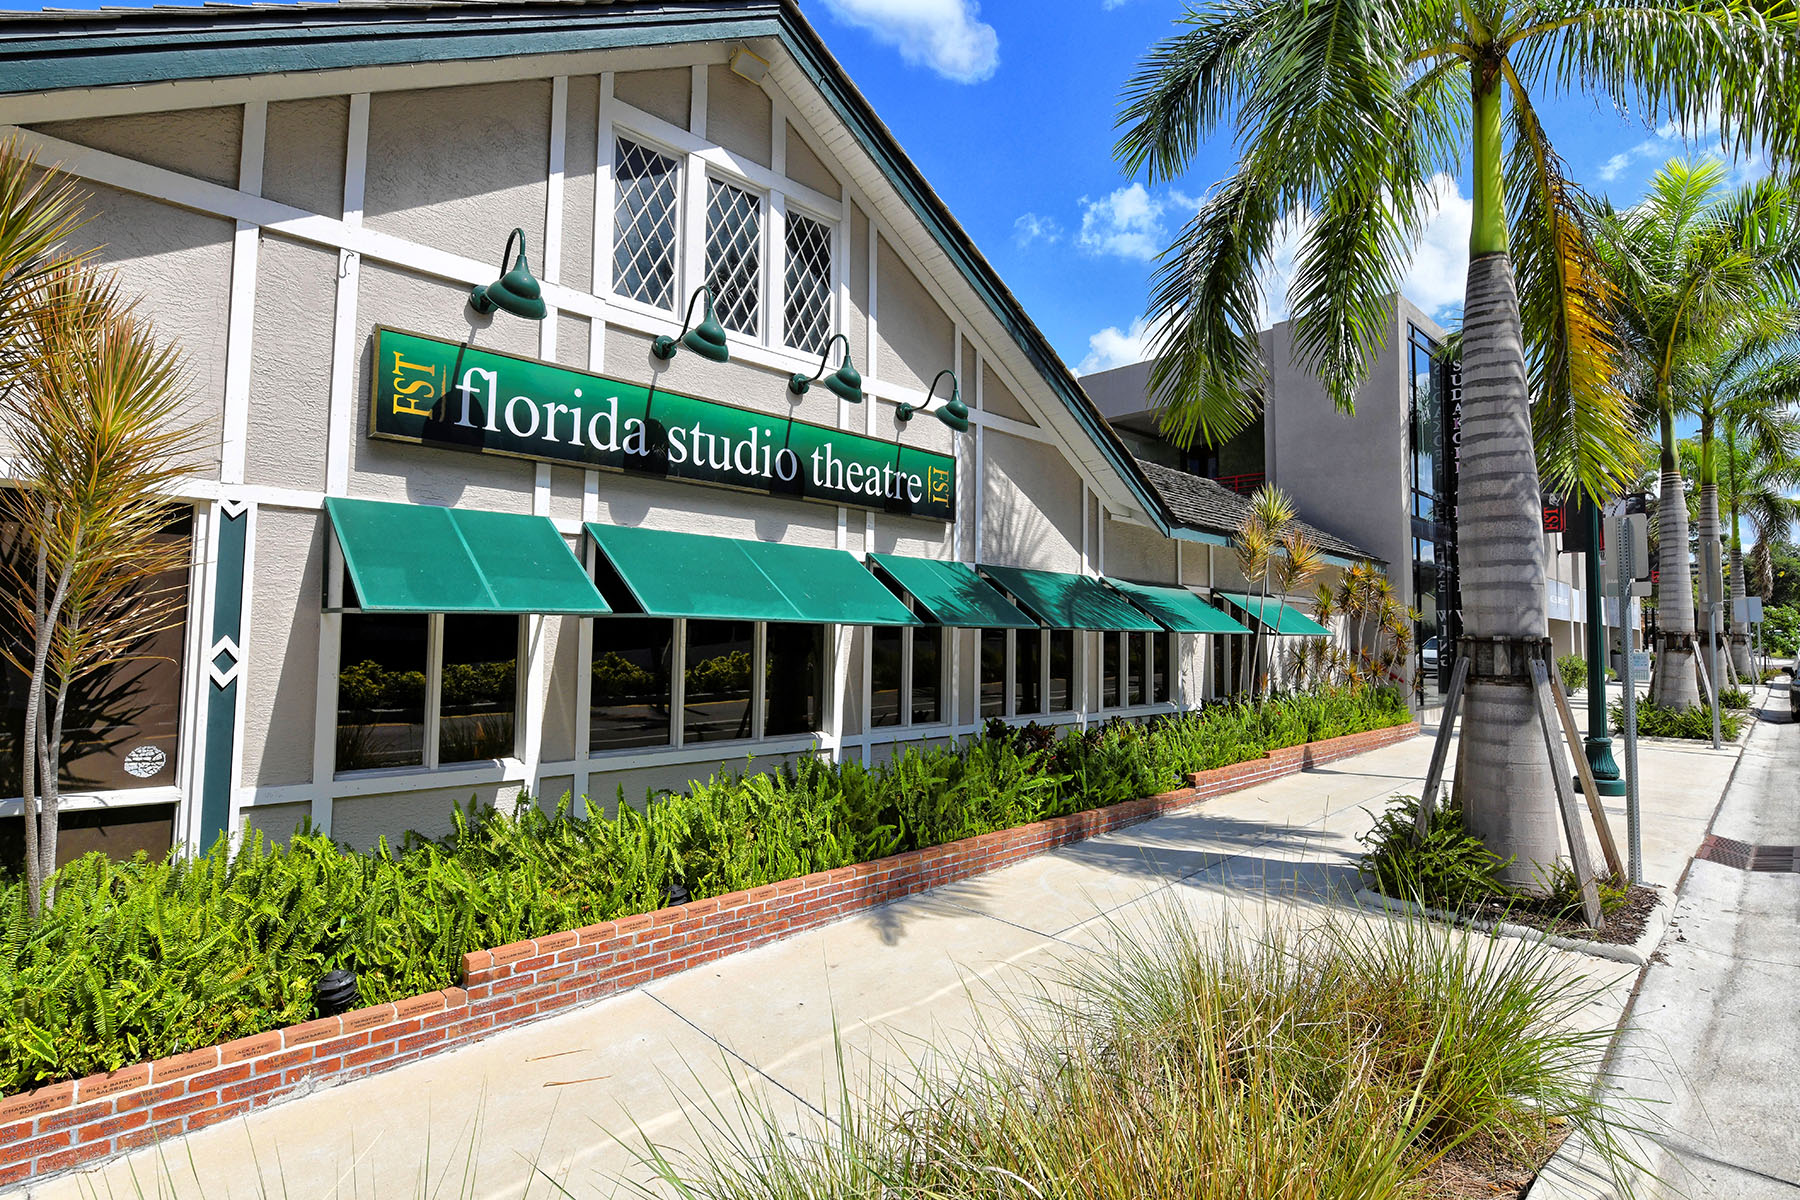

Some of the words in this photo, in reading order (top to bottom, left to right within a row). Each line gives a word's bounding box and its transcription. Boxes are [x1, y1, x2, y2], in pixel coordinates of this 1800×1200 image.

[392, 351, 435, 418] FST
[455, 366, 653, 456] florida
[667, 424, 798, 482] studio
[811, 442, 923, 503] theatre
[932, 468, 950, 508] FST
[1543, 506, 1559, 530] FST
[242, 1050, 261, 1058] SMITH
[158, 1067, 185, 1077] CAROLE
[86, 1086, 100, 1094] BILL
[109, 1075, 143, 1088] BARBARA
[96, 1083, 132, 1095] SALSBURY
[2, 1099, 47, 1115] CHARLOTTE
[19, 1103, 50, 1115] POPPER
